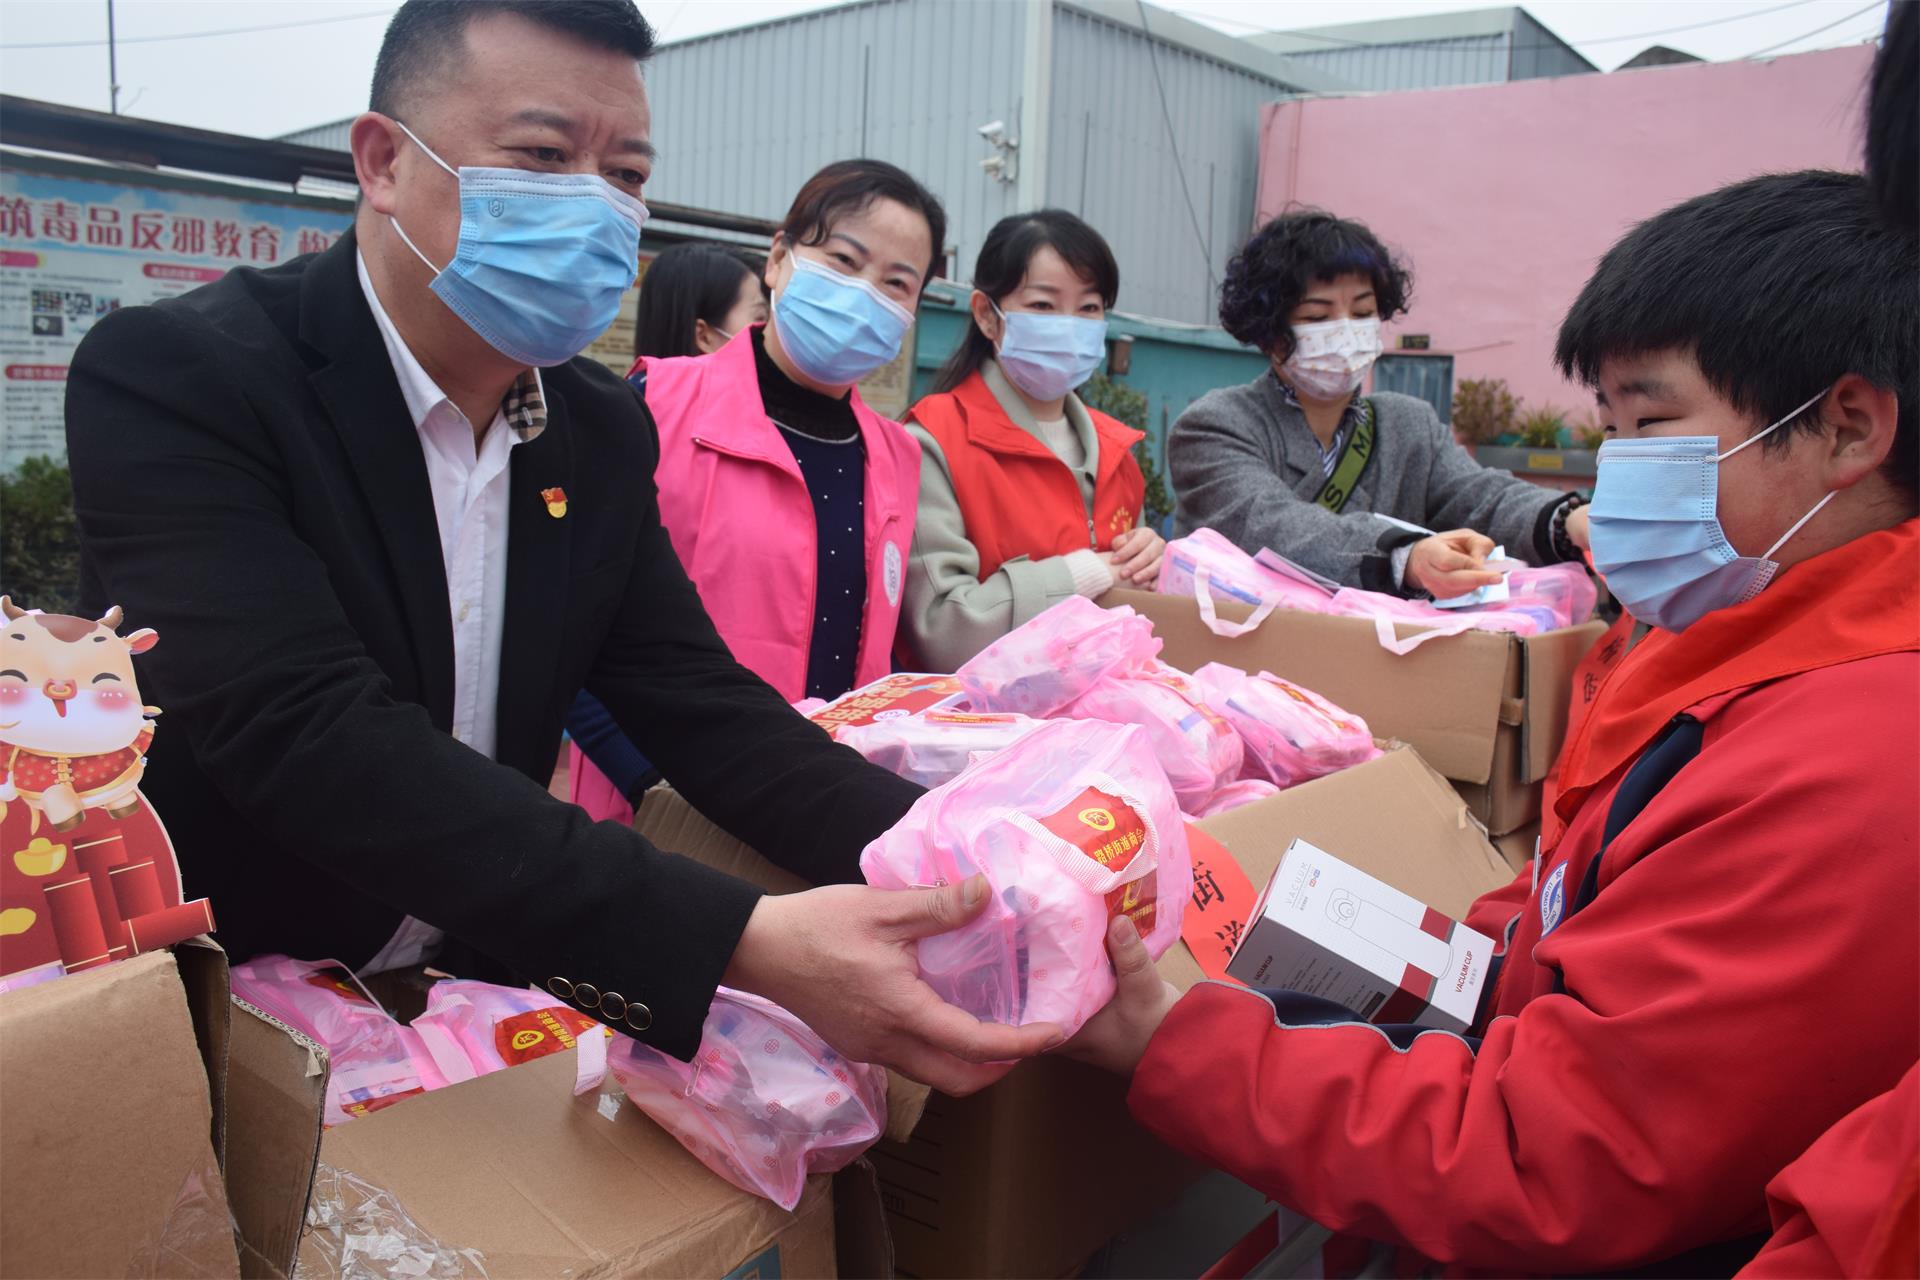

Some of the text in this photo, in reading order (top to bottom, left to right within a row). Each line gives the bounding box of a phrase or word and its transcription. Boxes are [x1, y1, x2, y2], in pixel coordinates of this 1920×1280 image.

[1093, 828, 1144, 866] 路桥街道商会
[1455, 963, 1469, 993] VACUUM
